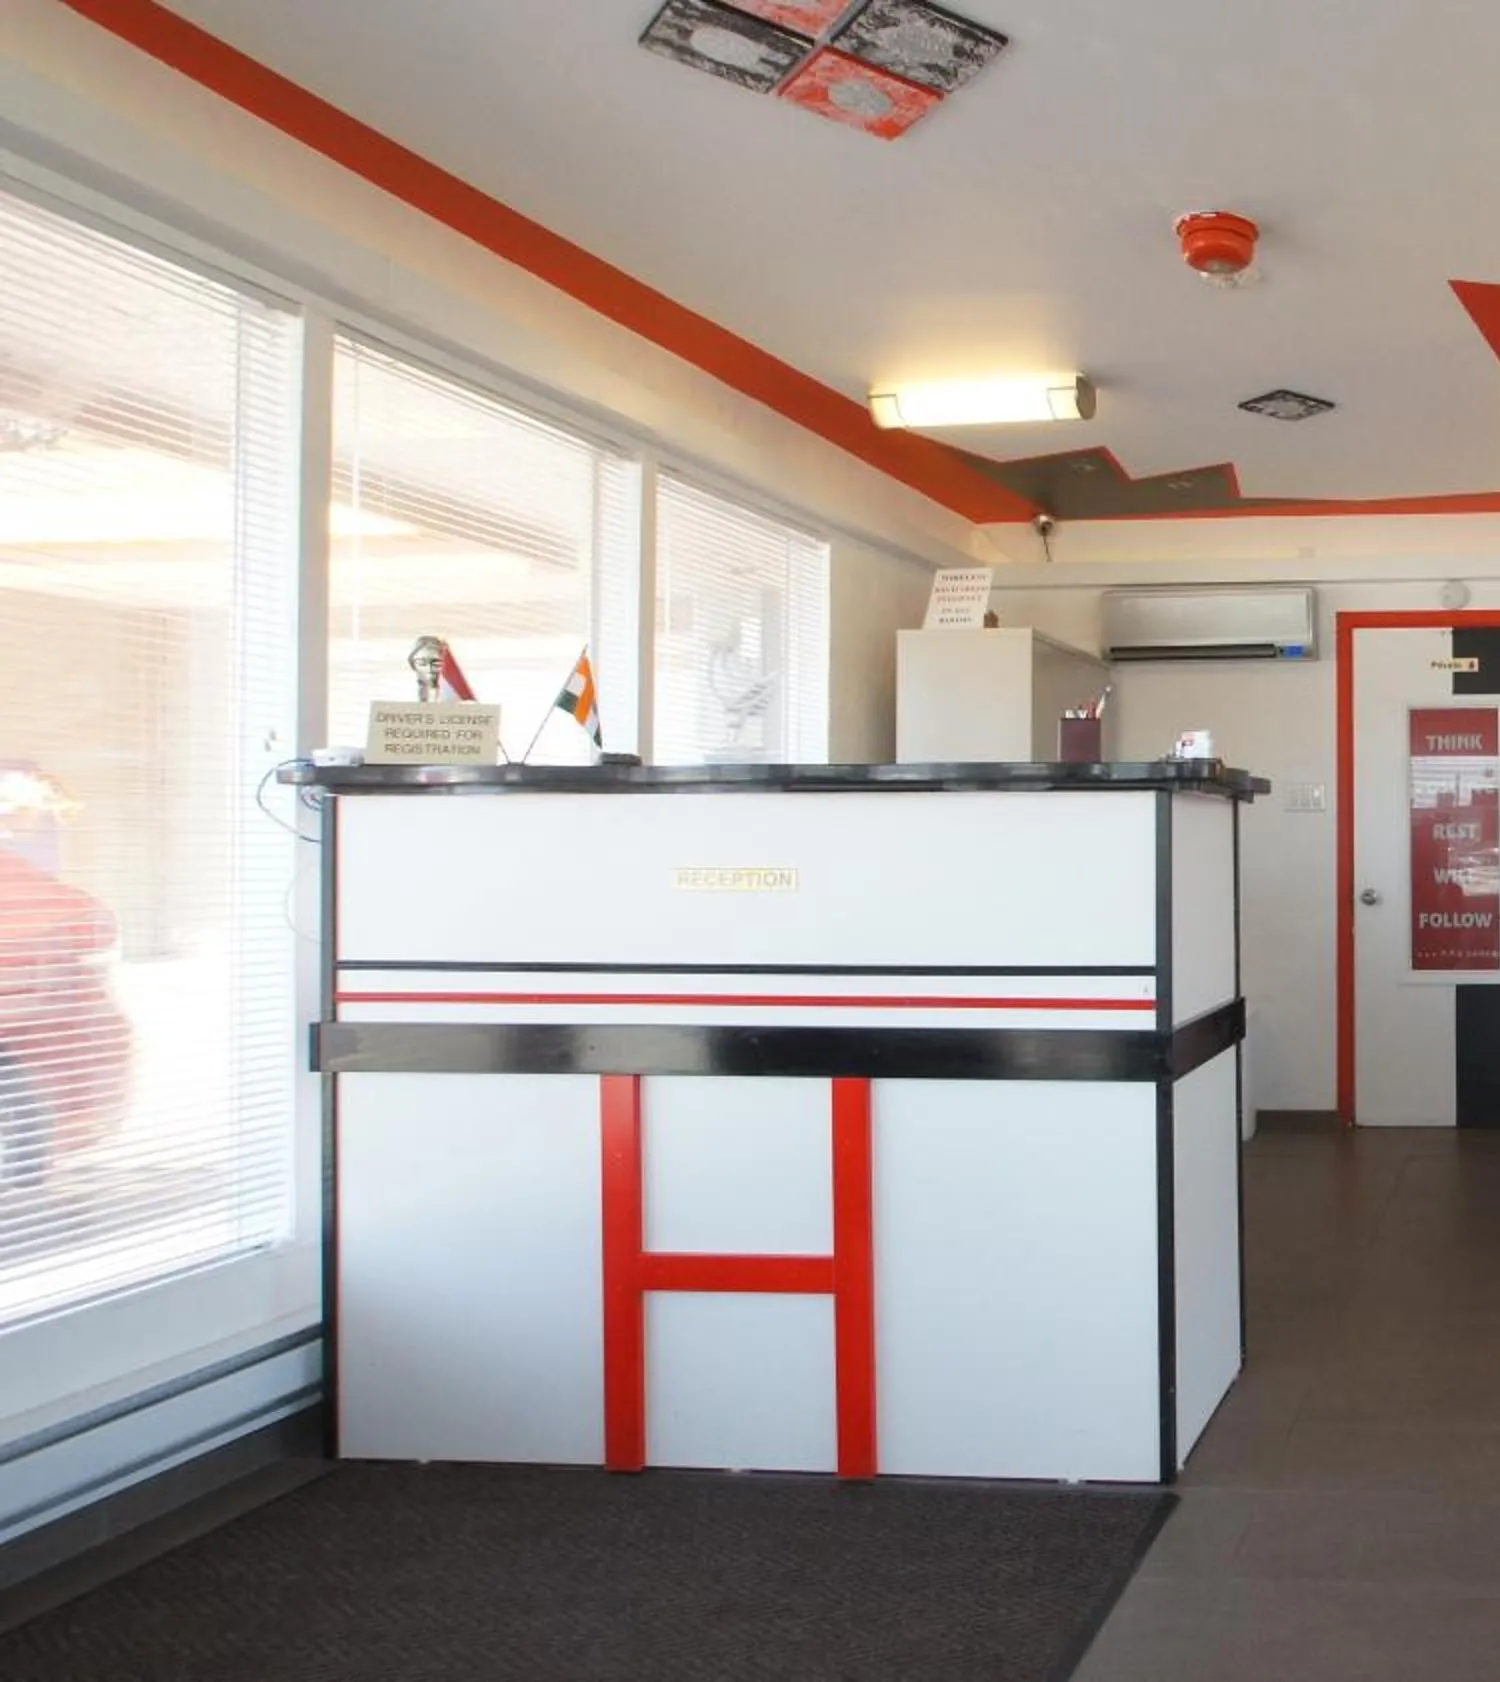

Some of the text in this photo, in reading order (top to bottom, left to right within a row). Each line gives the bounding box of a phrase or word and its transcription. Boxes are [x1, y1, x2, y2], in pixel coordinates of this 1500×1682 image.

[385, 727, 483, 740] REQUIRED FOR
[384, 743, 482, 755] REGISTRATION
[1426, 734, 1483, 751] THINK
[1432, 822, 1479, 841] REST
[676, 871, 793, 887] RECEPTION
[1418, 912, 1493, 929] FOLLOW
[601, 1074, 877, 1480] H
